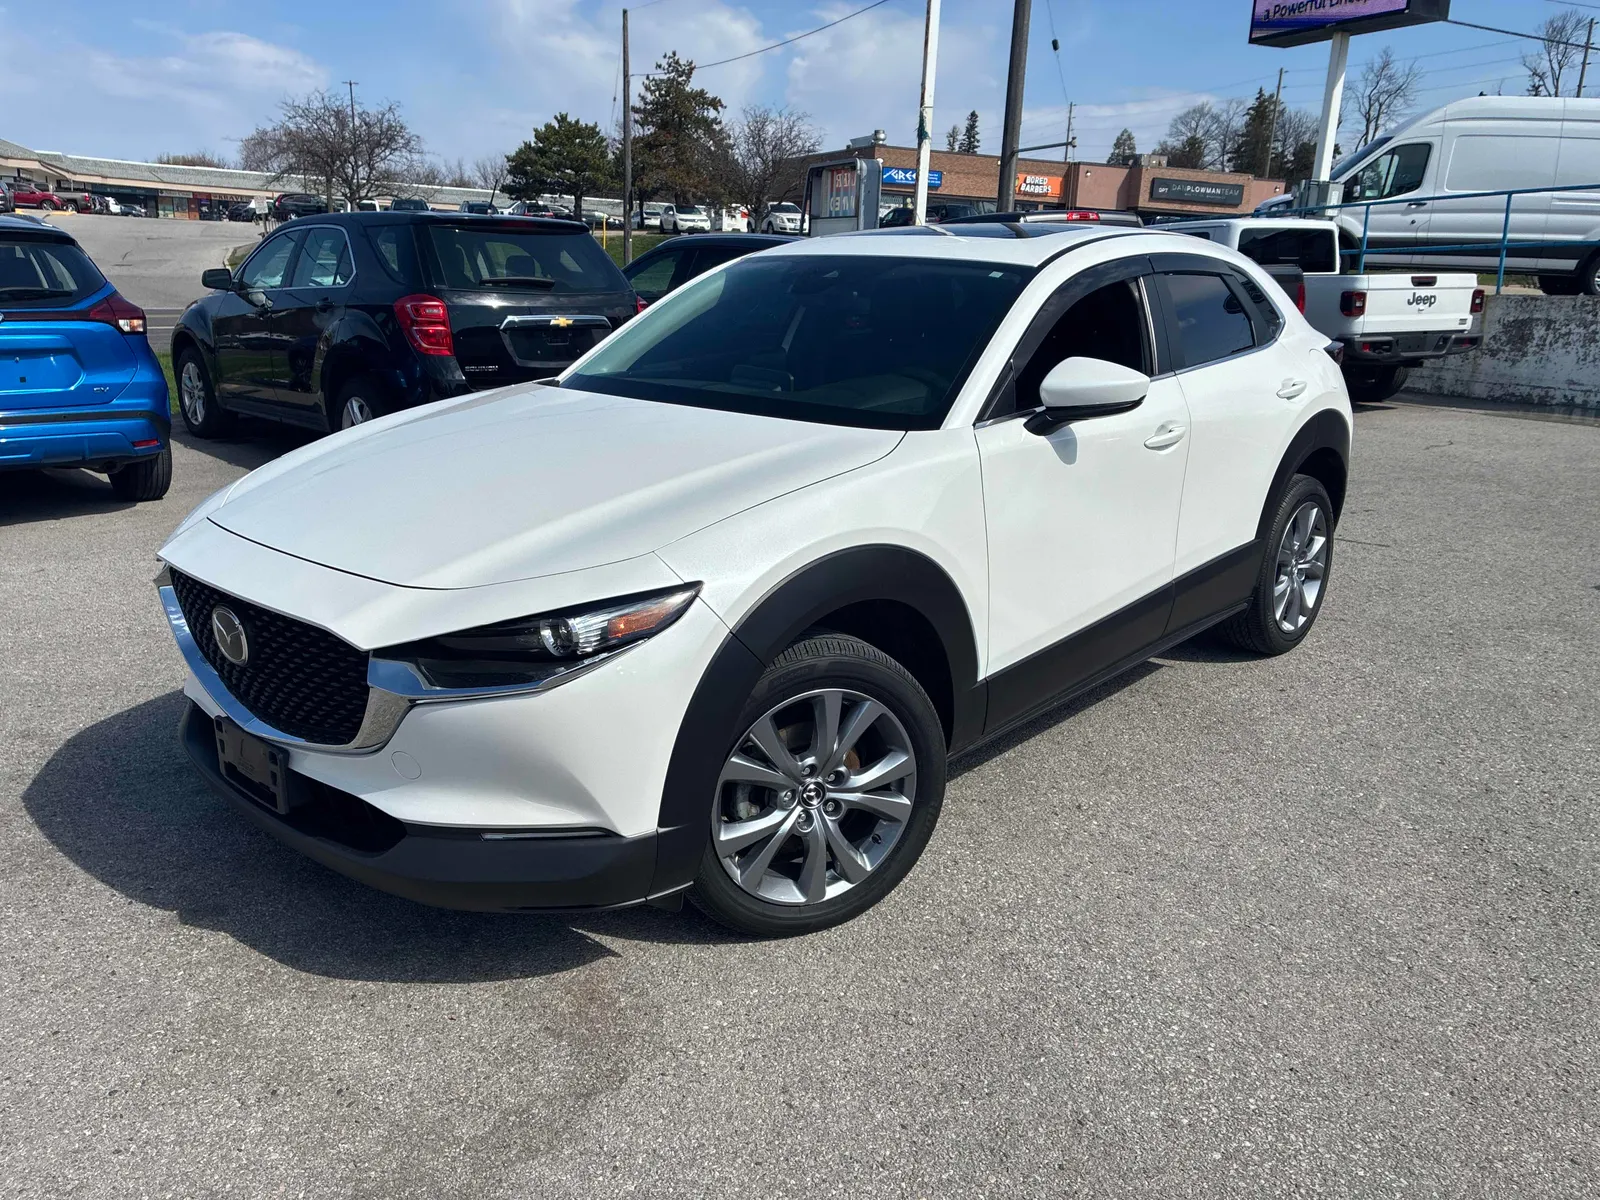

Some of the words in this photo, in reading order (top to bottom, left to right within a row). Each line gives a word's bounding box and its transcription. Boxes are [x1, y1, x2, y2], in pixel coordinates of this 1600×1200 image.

[1263, 9, 1270, 20] a
[1273, 0, 1326, 18] Powerful
[1026, 175, 1048, 185] BORED
[1020, 182, 1052, 193] BARBERS
[1407, 291, 1437, 308] Jeep
